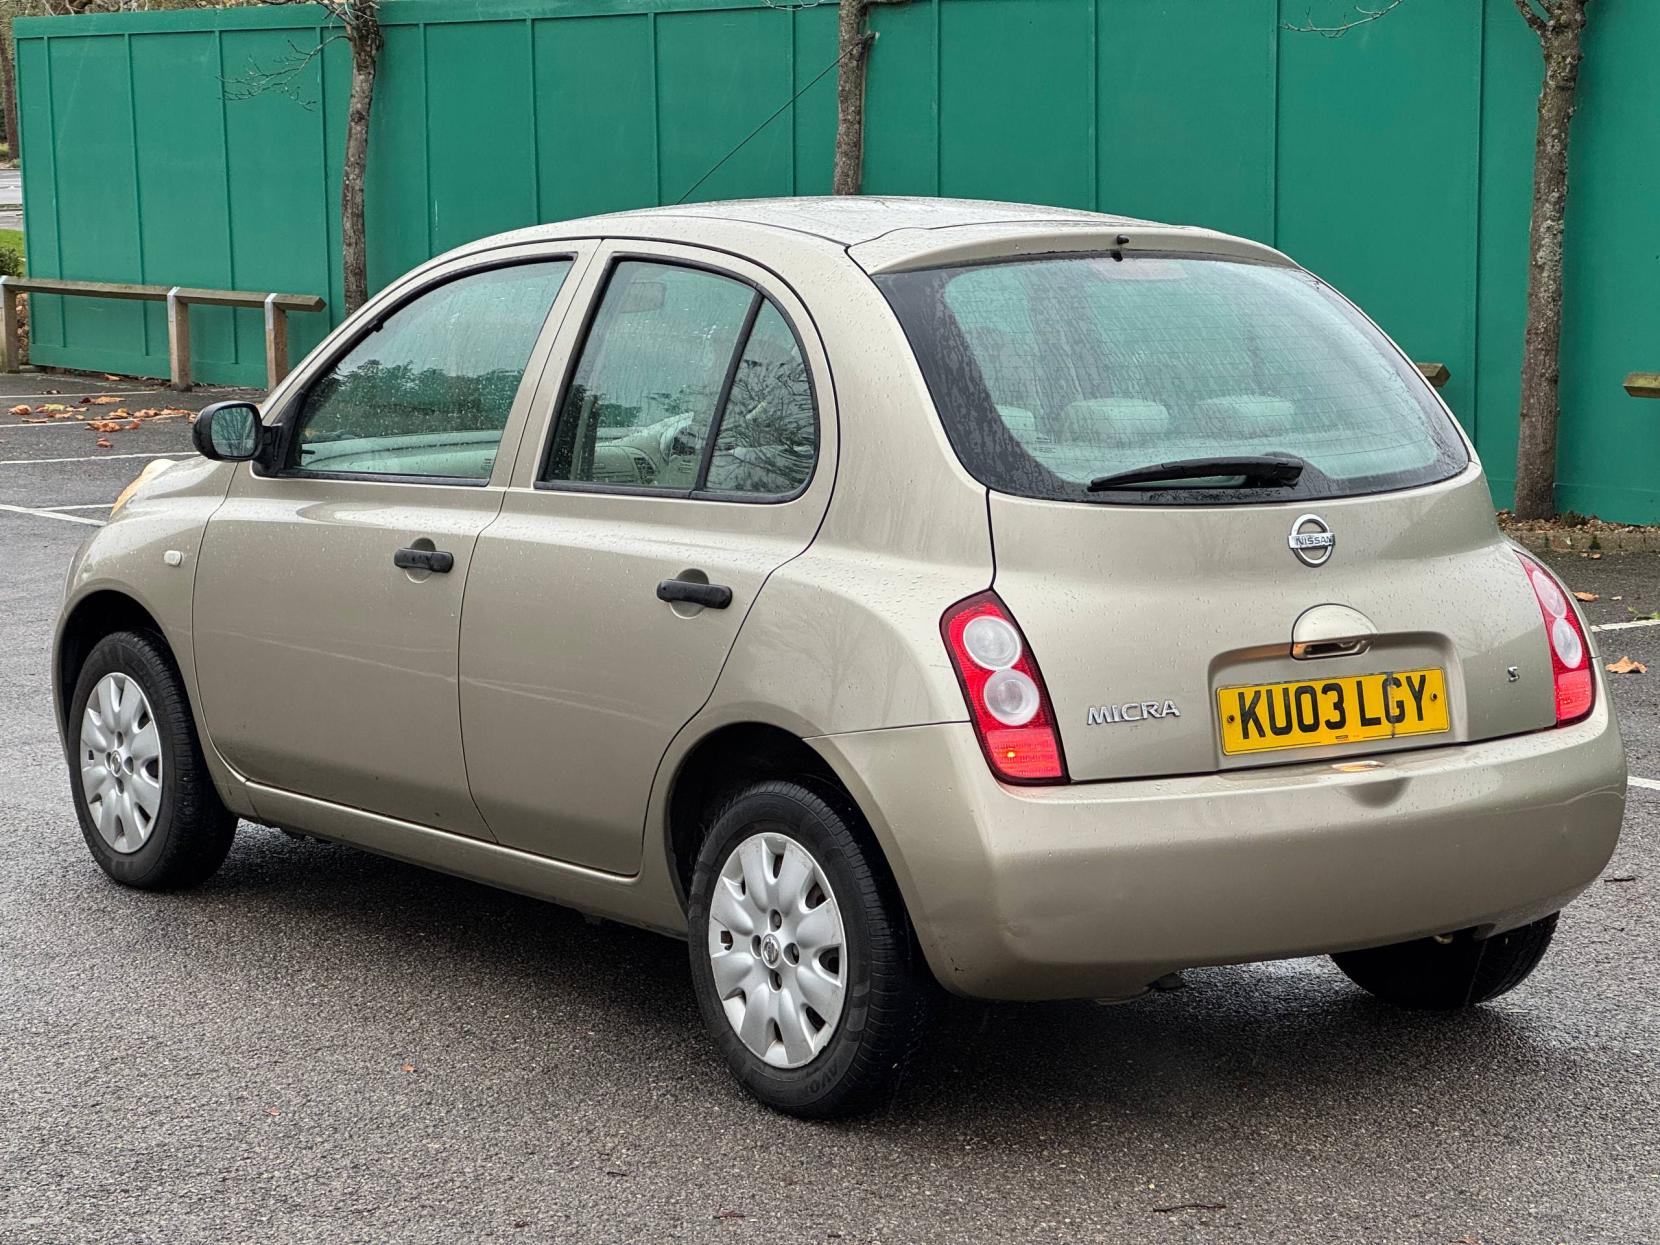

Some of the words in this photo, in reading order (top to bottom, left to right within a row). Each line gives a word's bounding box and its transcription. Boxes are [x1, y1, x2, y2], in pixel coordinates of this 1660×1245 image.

[1295, 534, 1332, 546] NISSAN
[1086, 699, 1181, 725] MICRA
[1237, 682, 1347, 740] KU03
[1355, 674, 1427, 728] LGY
